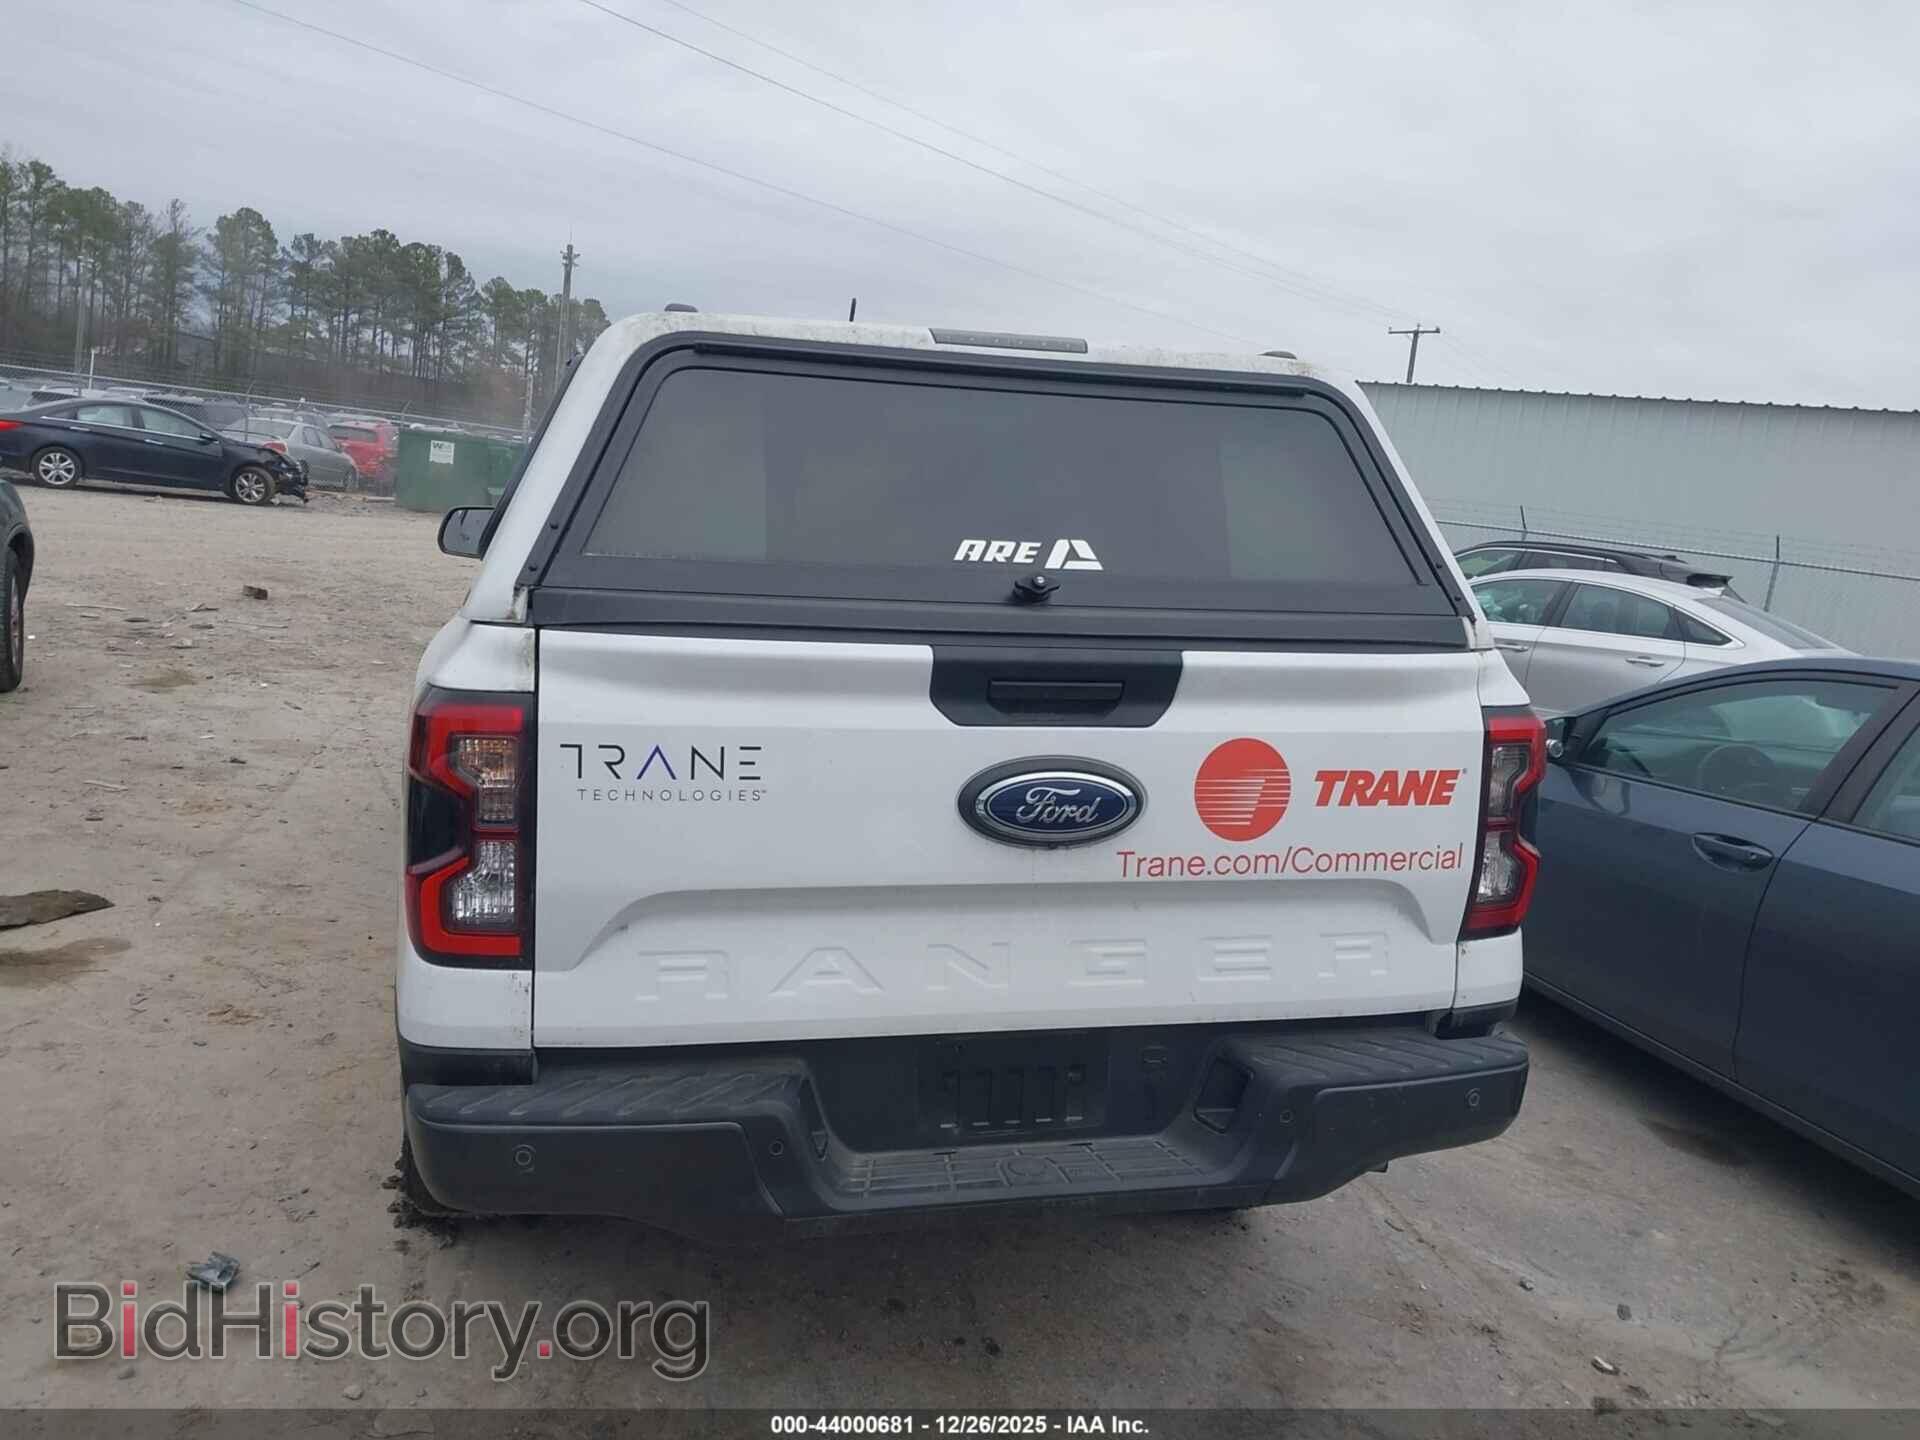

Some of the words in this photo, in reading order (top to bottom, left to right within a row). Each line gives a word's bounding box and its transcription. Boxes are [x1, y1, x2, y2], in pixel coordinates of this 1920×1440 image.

[953, 539, 1042, 563] ARE
[560, 743, 763, 780] TRANE
[577, 788, 763, 802] TECHNOLOGIES
[1016, 786, 1100, 825] Ford
[1313, 769, 1461, 807] TRANE
[1116, 842, 1464, 879] Trane.com/Commercial
[635, 929, 1391, 1001] RANGER
